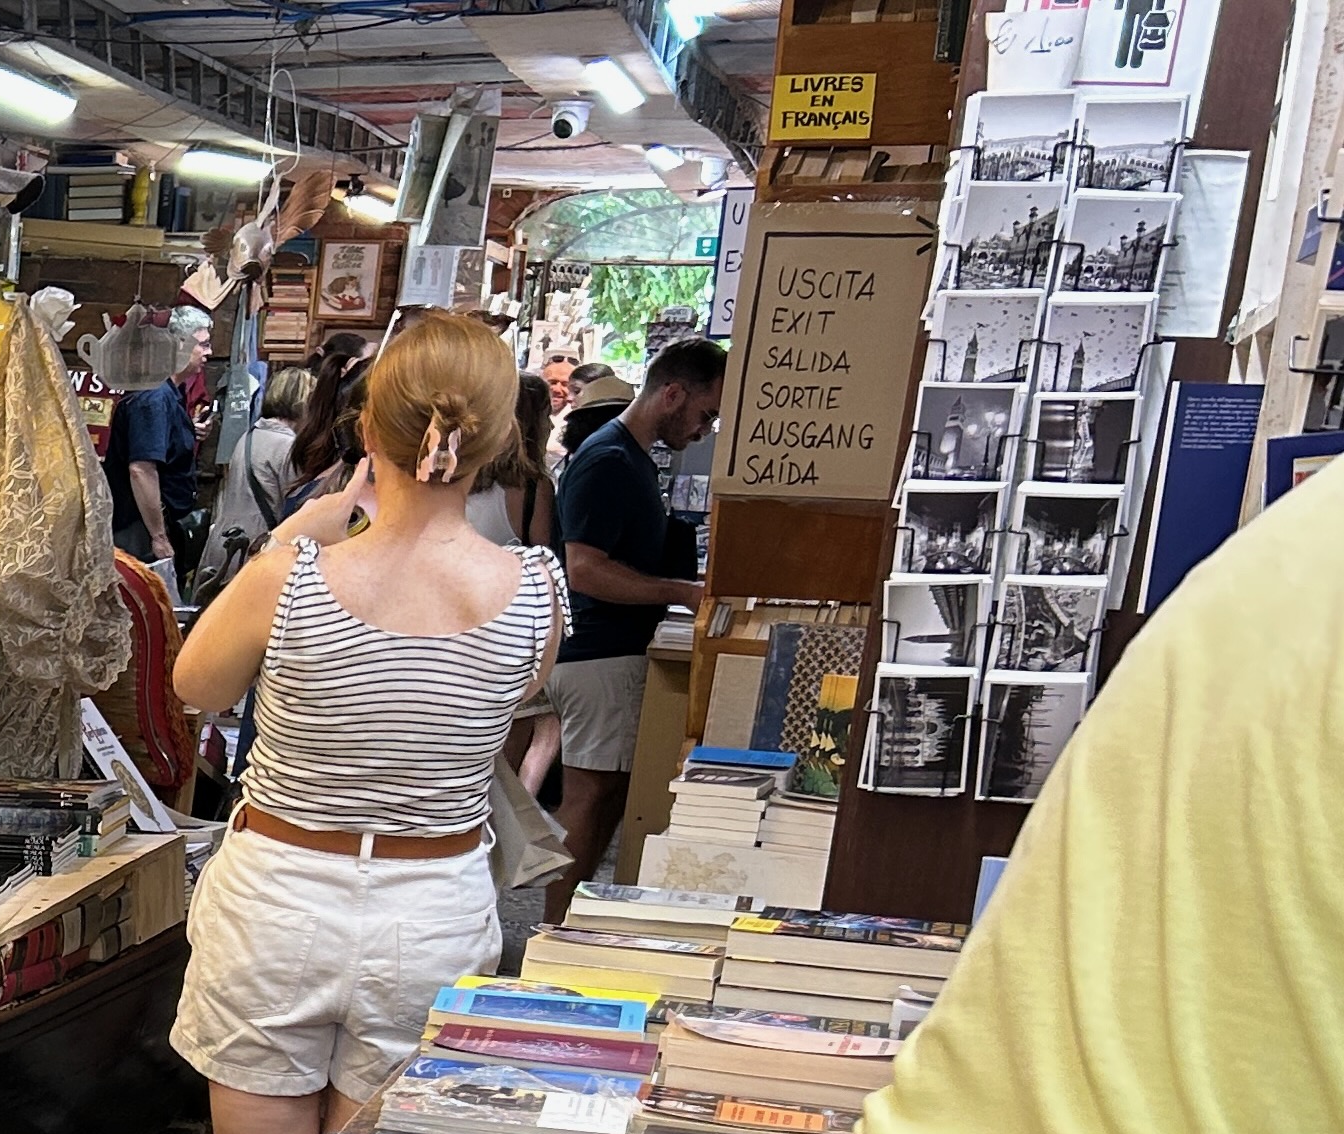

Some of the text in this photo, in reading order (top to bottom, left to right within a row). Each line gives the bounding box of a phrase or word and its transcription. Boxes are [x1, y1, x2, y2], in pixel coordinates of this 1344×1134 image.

[790, 76, 864, 93] LIVRES
[810, 95, 834, 107] EN
[781, 110, 870, 130] FRANÇAIS
[778, 266, 875, 301] USCITA
[771, 307, 835, 335] EXIT
[763, 346, 851, 374] SALIDA
[757, 382, 842, 410] SORTIE
[749, 418, 874, 450] AUSGANG
[742, 453, 819, 485] SAÍDA
